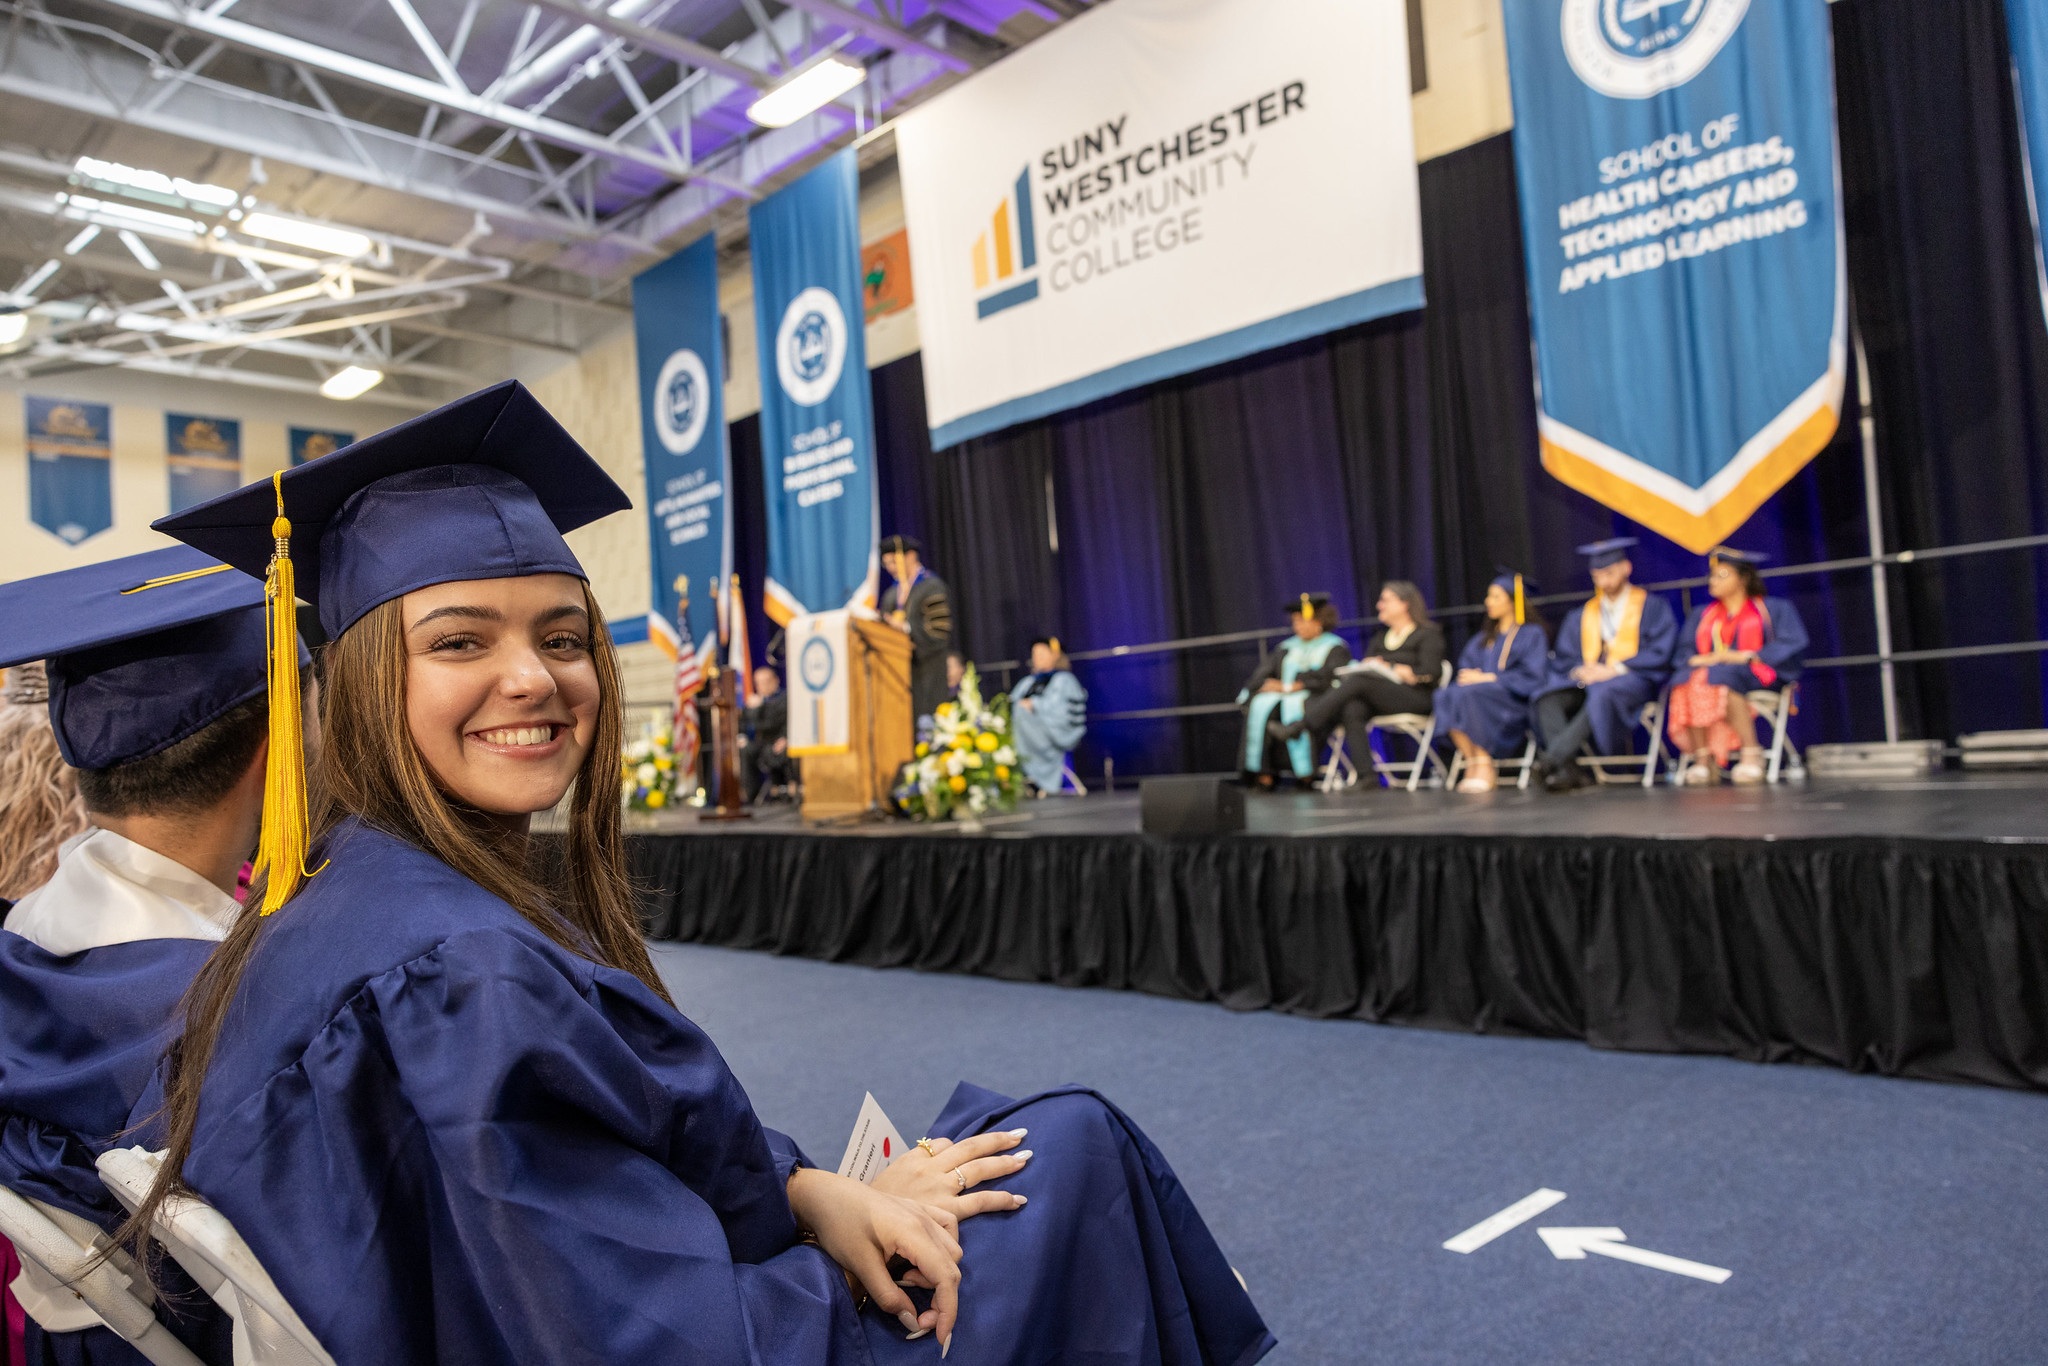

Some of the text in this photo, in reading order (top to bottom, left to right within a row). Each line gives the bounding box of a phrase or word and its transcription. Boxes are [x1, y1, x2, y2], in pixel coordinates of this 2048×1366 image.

[1042, 114, 1128, 179] SUNY
[1044, 79, 1307, 216] WESTCHESTER
[1558, 135, 1796, 230] HEALTH CAREERS,
[1599, 112, 1740, 184] SCHOOL OF
[1046, 141, 1257, 255] COMMUNITY
[1560, 167, 1799, 260] TECHNOLOGY AND
[1049, 205, 1204, 293] COLLEGE
[1558, 199, 1808, 295] APPLIED LEARNING
[859, 1143, 876, 1181] Granieri
